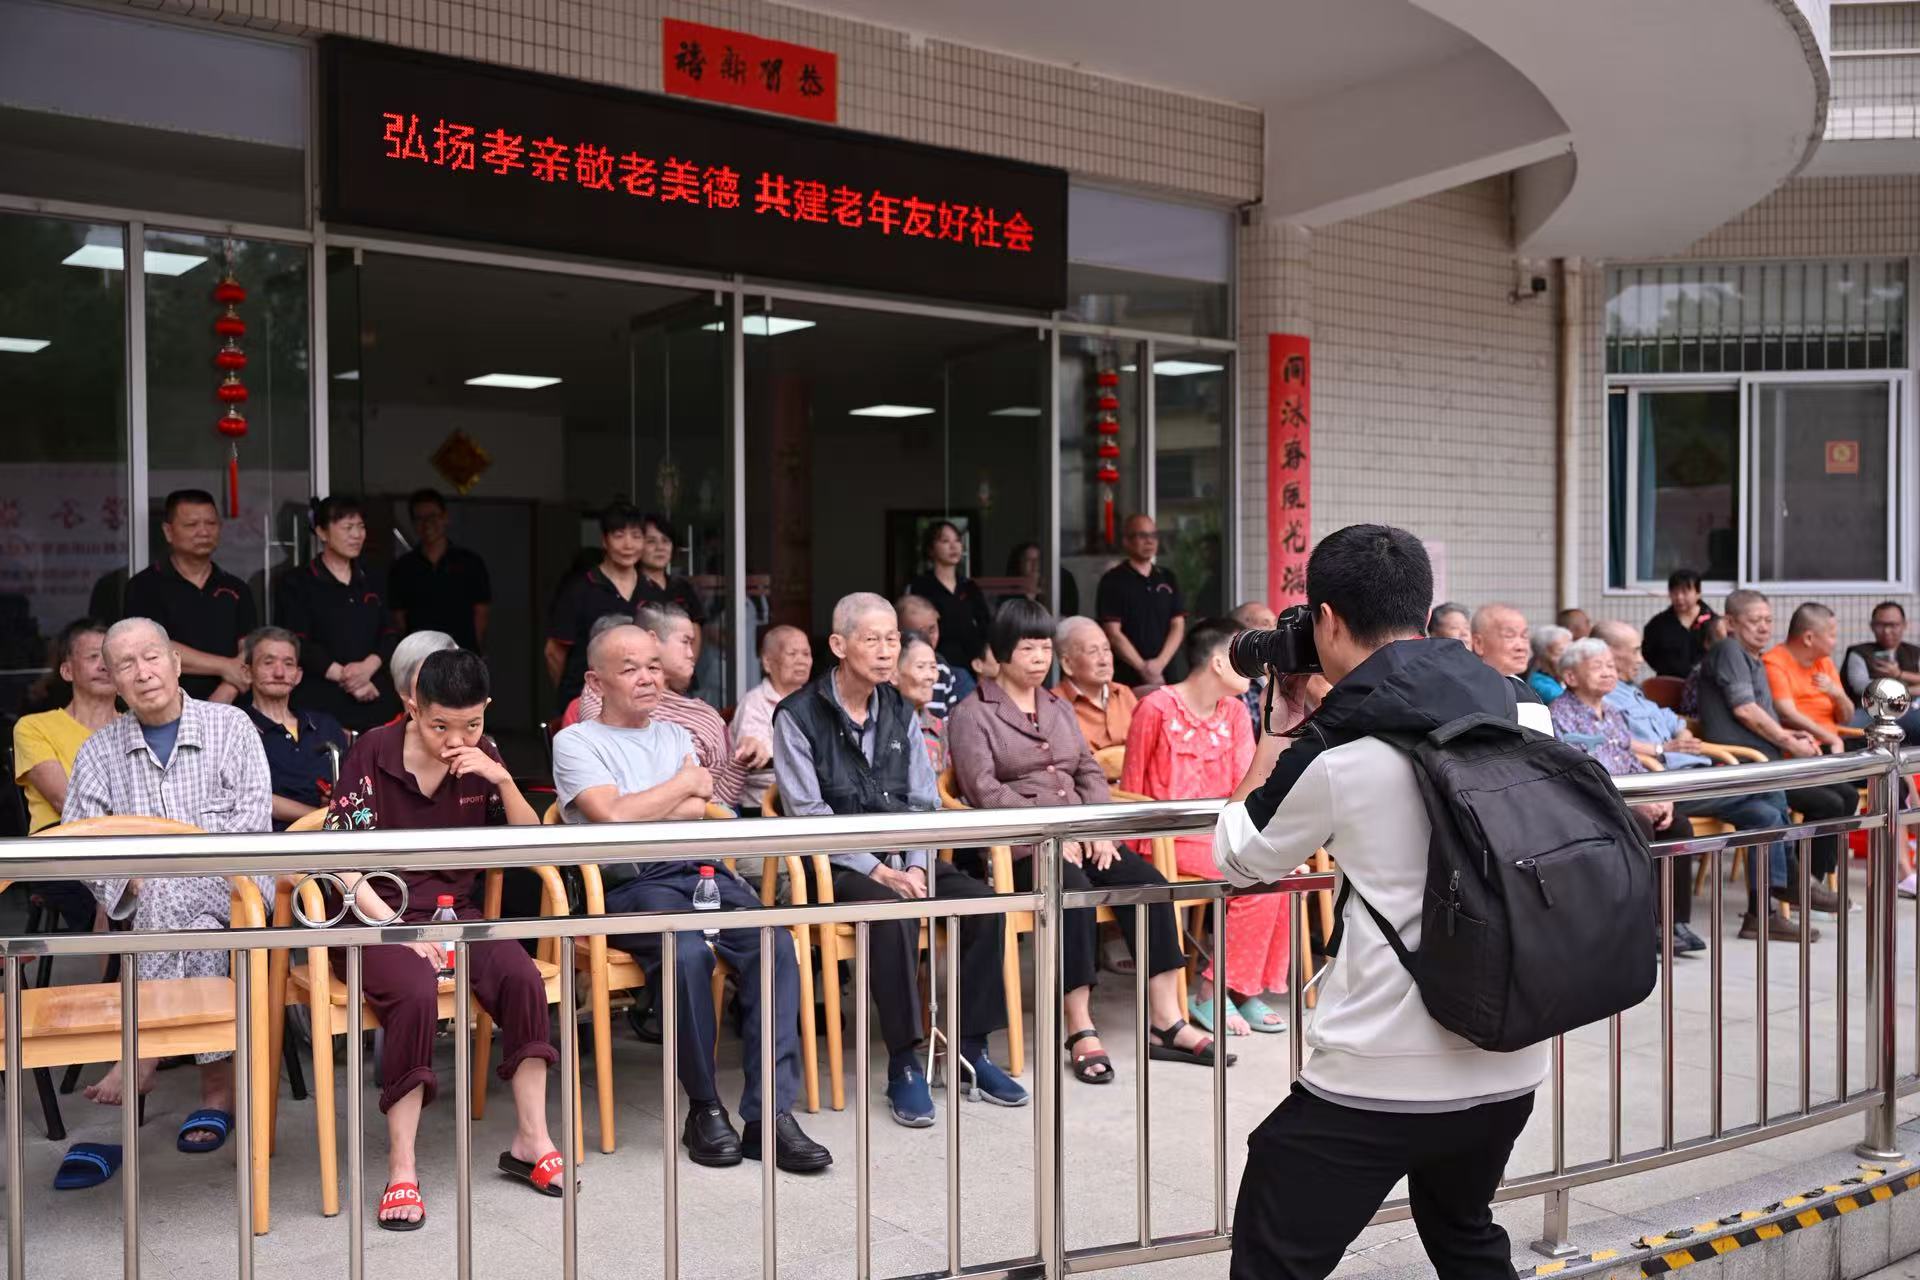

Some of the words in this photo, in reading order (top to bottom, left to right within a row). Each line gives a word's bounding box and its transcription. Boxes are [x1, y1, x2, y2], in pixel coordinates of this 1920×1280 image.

[384, 113, 739, 208] 弘扬孝亲敬老美德
[755, 172, 1033, 251] 共建老年友好社会
[383, 1188, 421, 1205] Tracy
